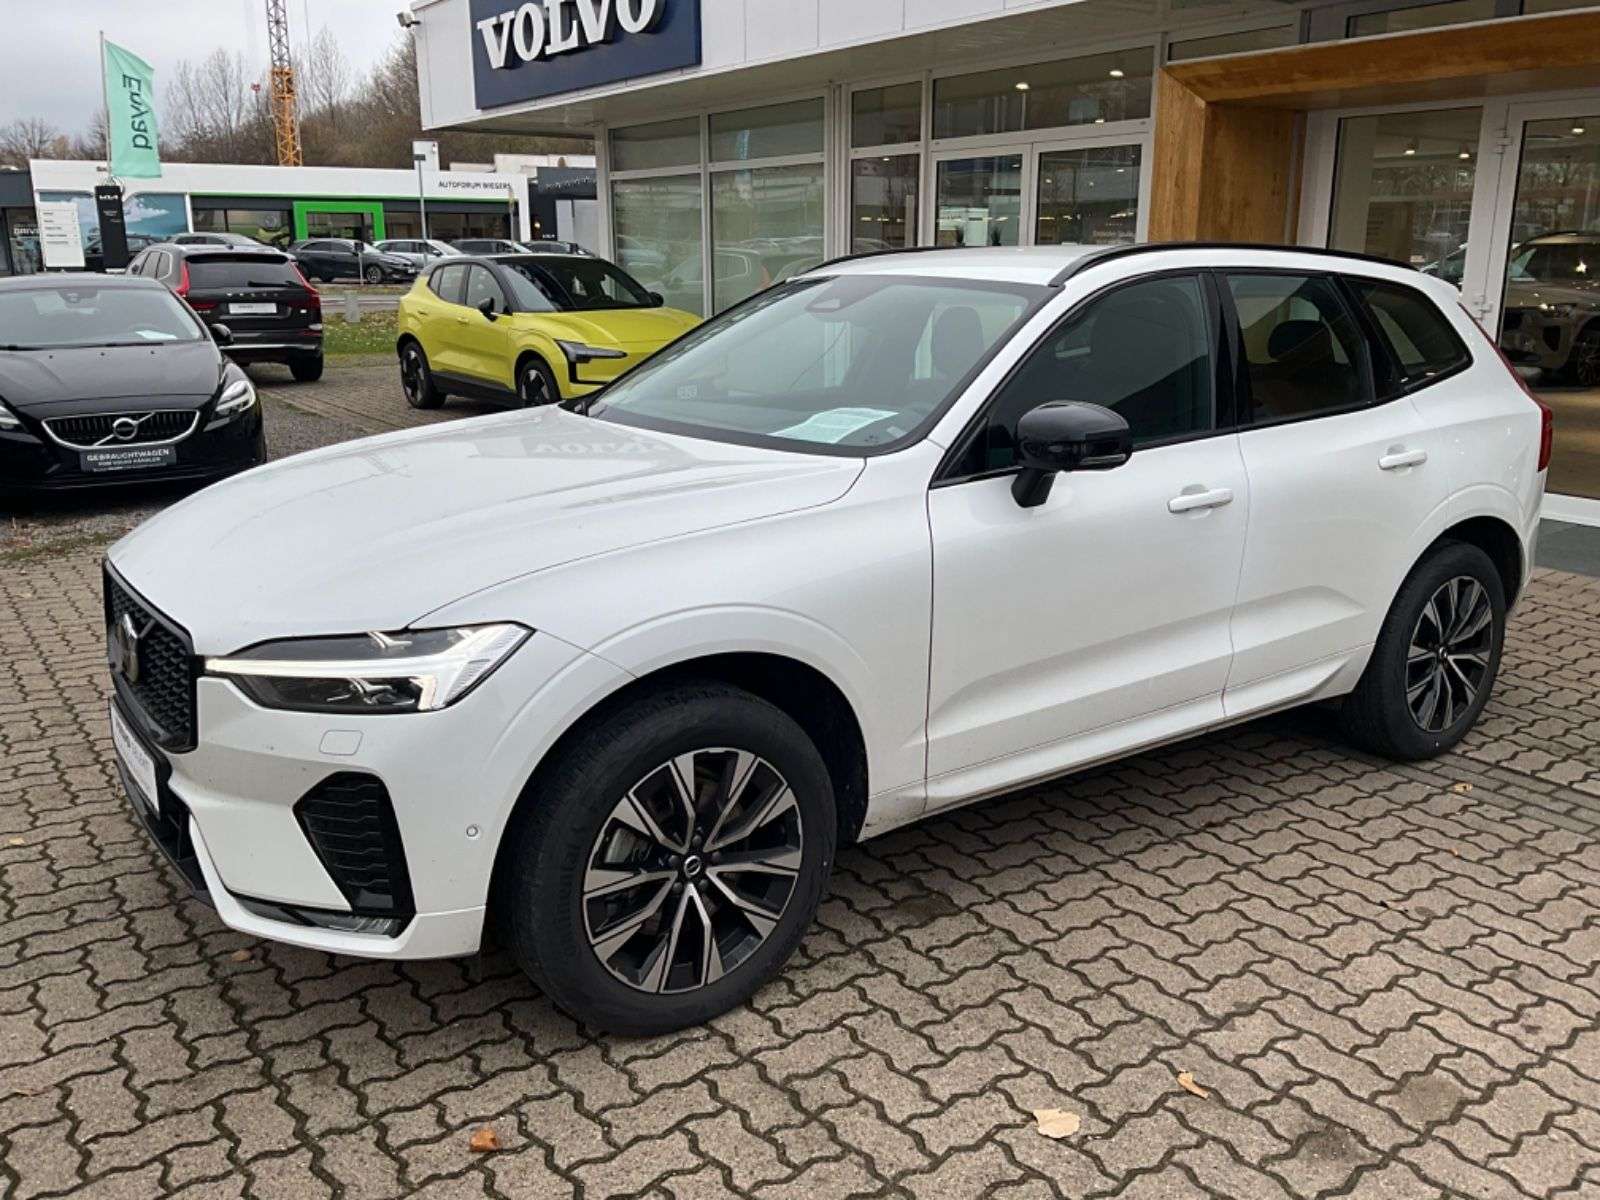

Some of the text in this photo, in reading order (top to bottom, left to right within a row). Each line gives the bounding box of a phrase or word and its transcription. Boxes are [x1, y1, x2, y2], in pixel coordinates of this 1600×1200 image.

[477, 0, 657, 70] VOLVO
[438, 181, 481, 189] AUTOFORUM
[87, 449, 169, 461] GEBRAUCHTWAGEN
